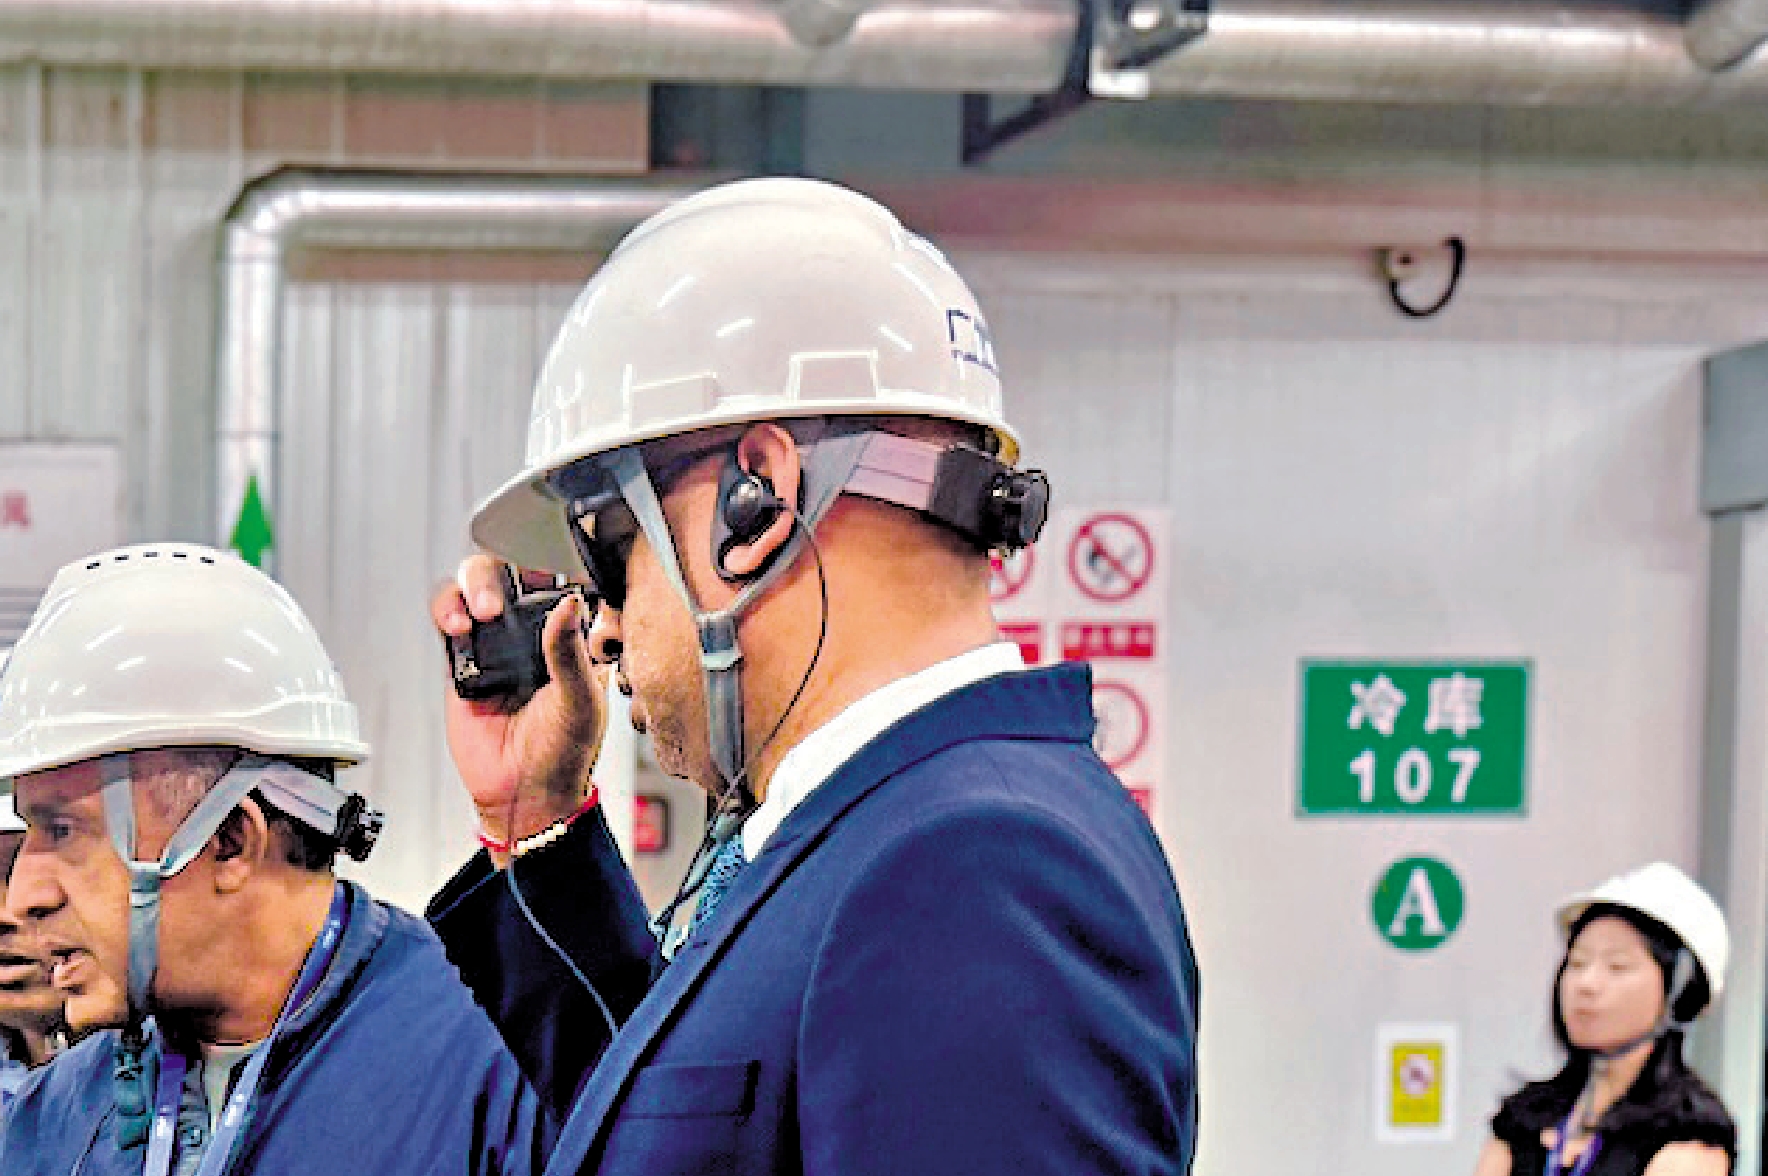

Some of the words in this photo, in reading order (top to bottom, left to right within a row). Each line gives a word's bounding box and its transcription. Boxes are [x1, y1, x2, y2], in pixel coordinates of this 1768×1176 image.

[1347, 672, 1484, 736] 冷库
[1349, 748, 1481, 804] 107
[1389, 866, 1445, 936] A
